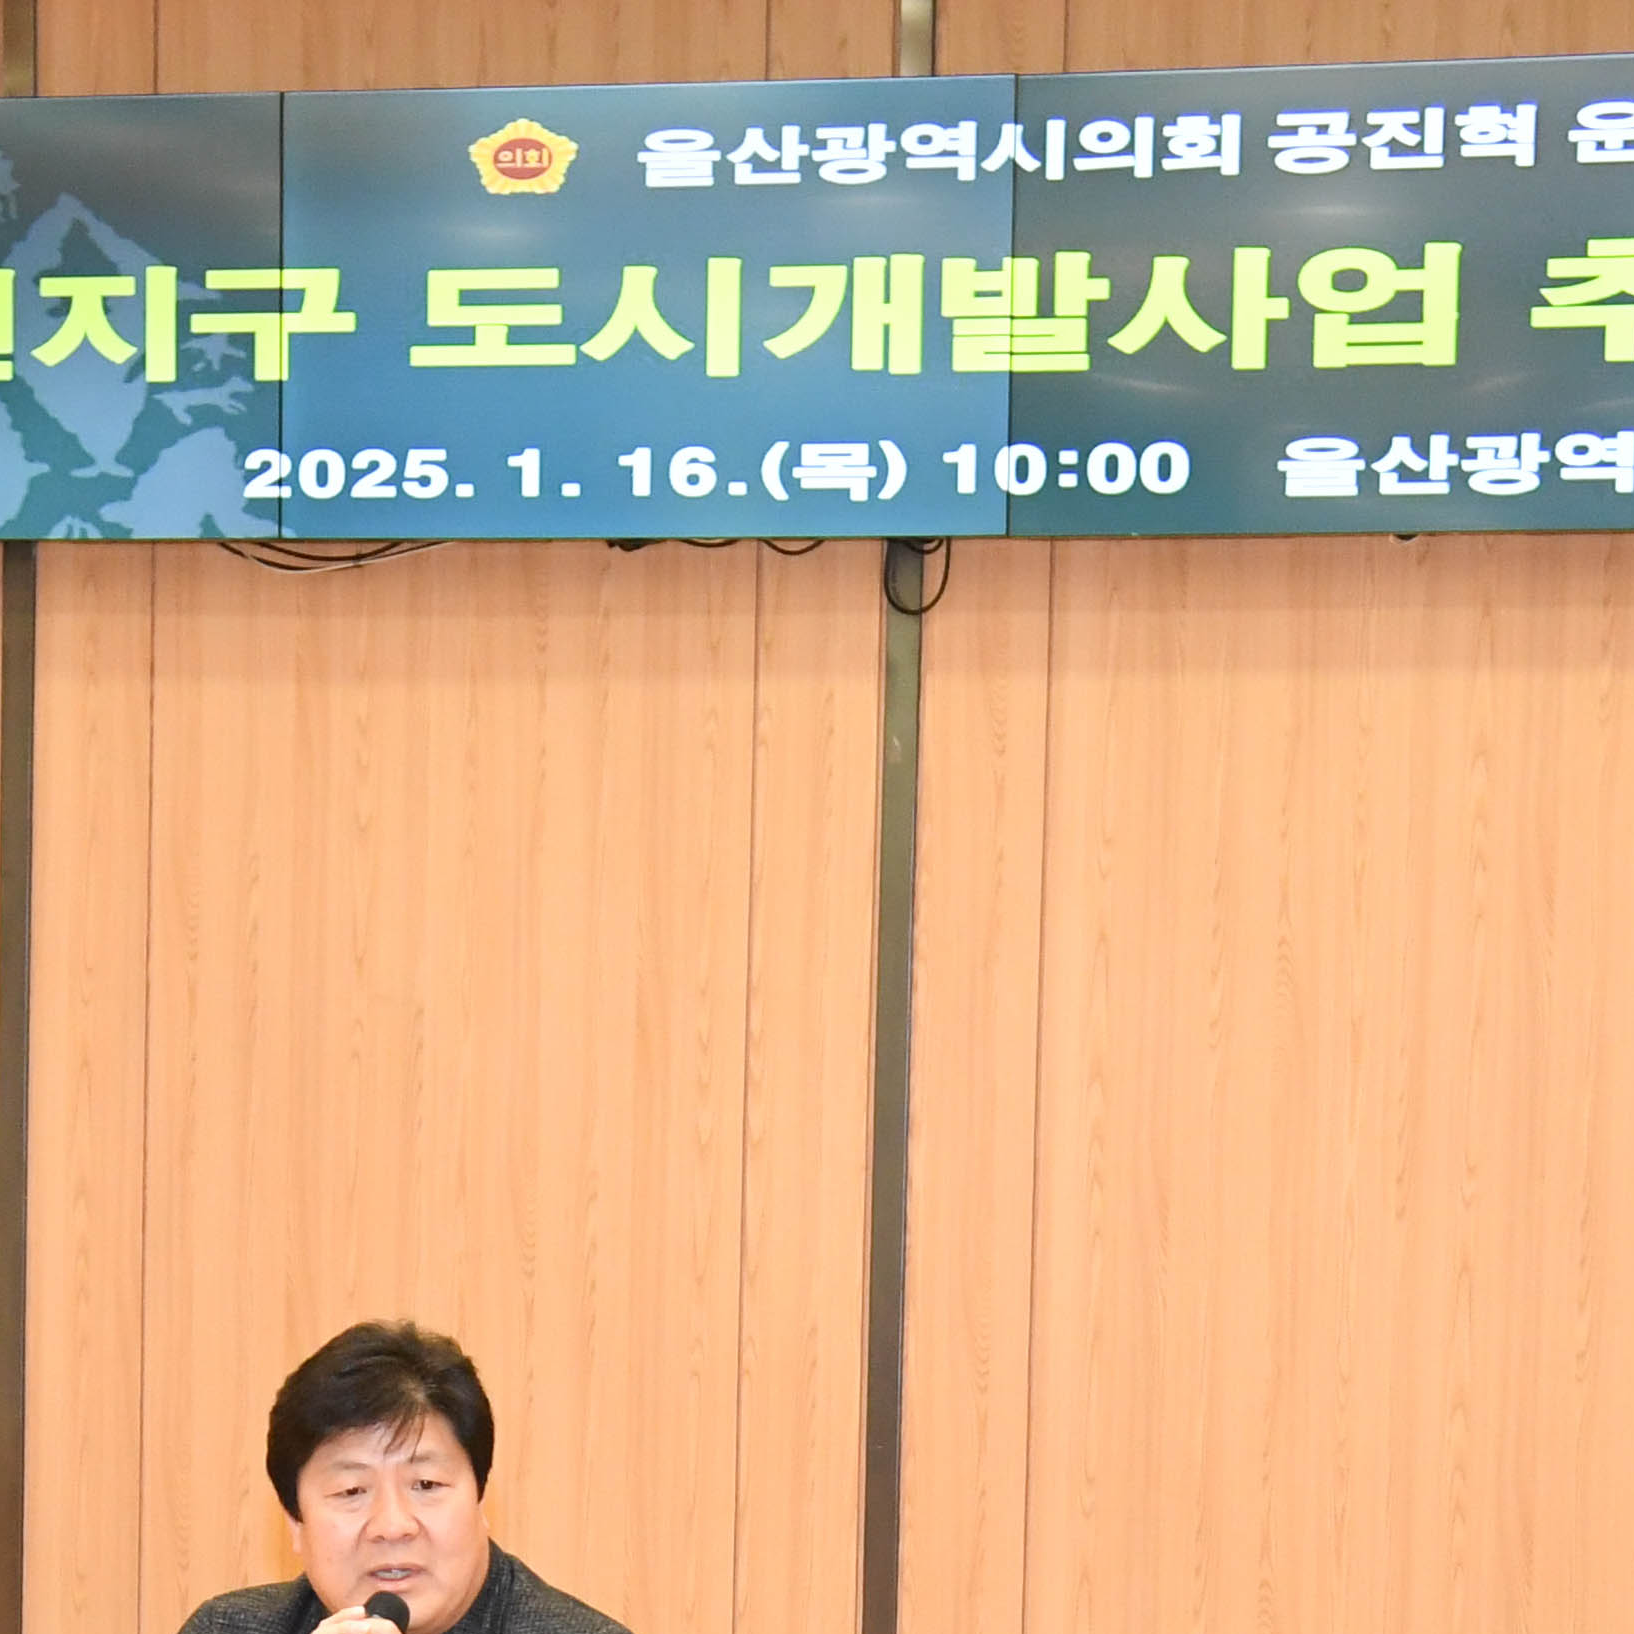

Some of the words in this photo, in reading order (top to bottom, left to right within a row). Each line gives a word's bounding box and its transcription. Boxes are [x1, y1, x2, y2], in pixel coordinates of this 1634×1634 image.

[495, 147, 551, 169] 의회
[637, 113, 1241, 188] 울산광역시의회
[1267, 103, 1537, 175] 공진혁
[409, 241, 1463, 378] 도시개발사업
[243, 448, 474, 500] 2025.
[507, 448, 581, 498] 1.
[942, 441, 1190, 496] 10:00
